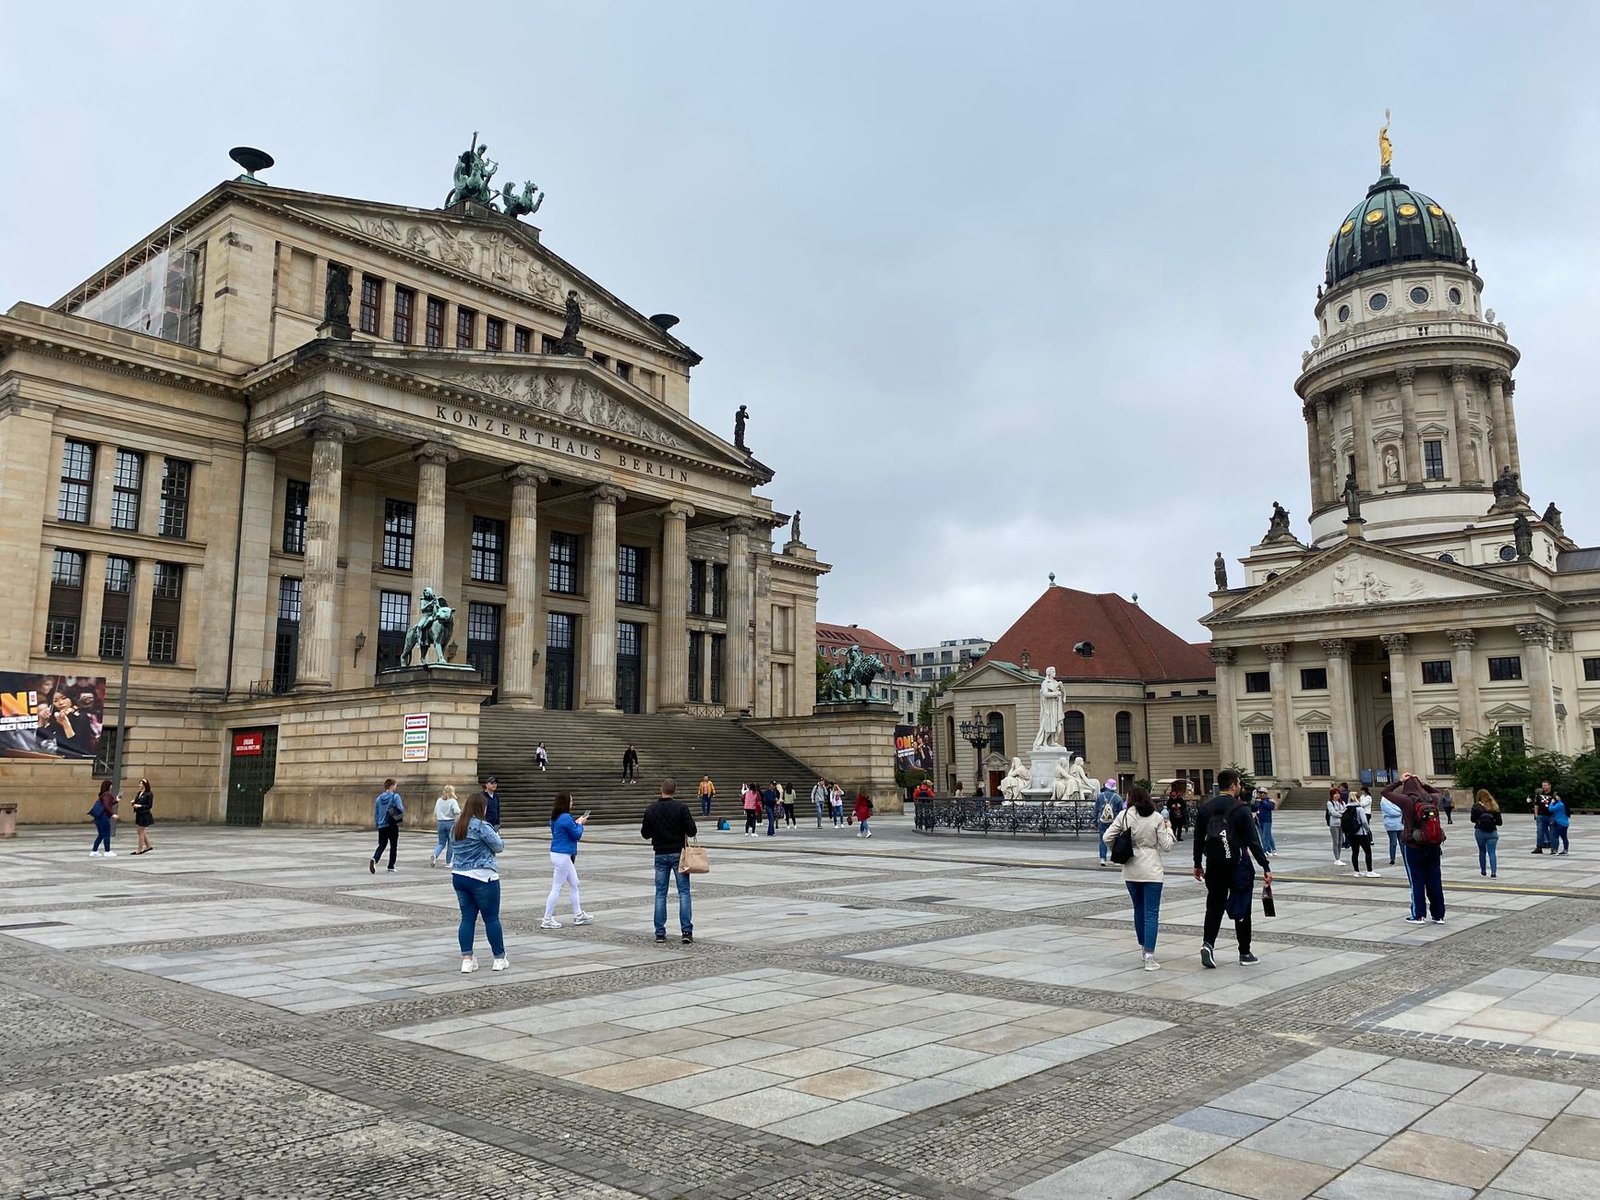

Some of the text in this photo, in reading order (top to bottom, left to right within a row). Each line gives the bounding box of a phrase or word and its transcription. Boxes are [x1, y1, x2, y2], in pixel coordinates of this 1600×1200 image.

[436, 405, 689, 482] KONZERTHAUS BERLIN
[0, 691, 38, 716] N!
[896, 735, 914, 750] ON!
[1221, 835, 1231, 859] Reebok
